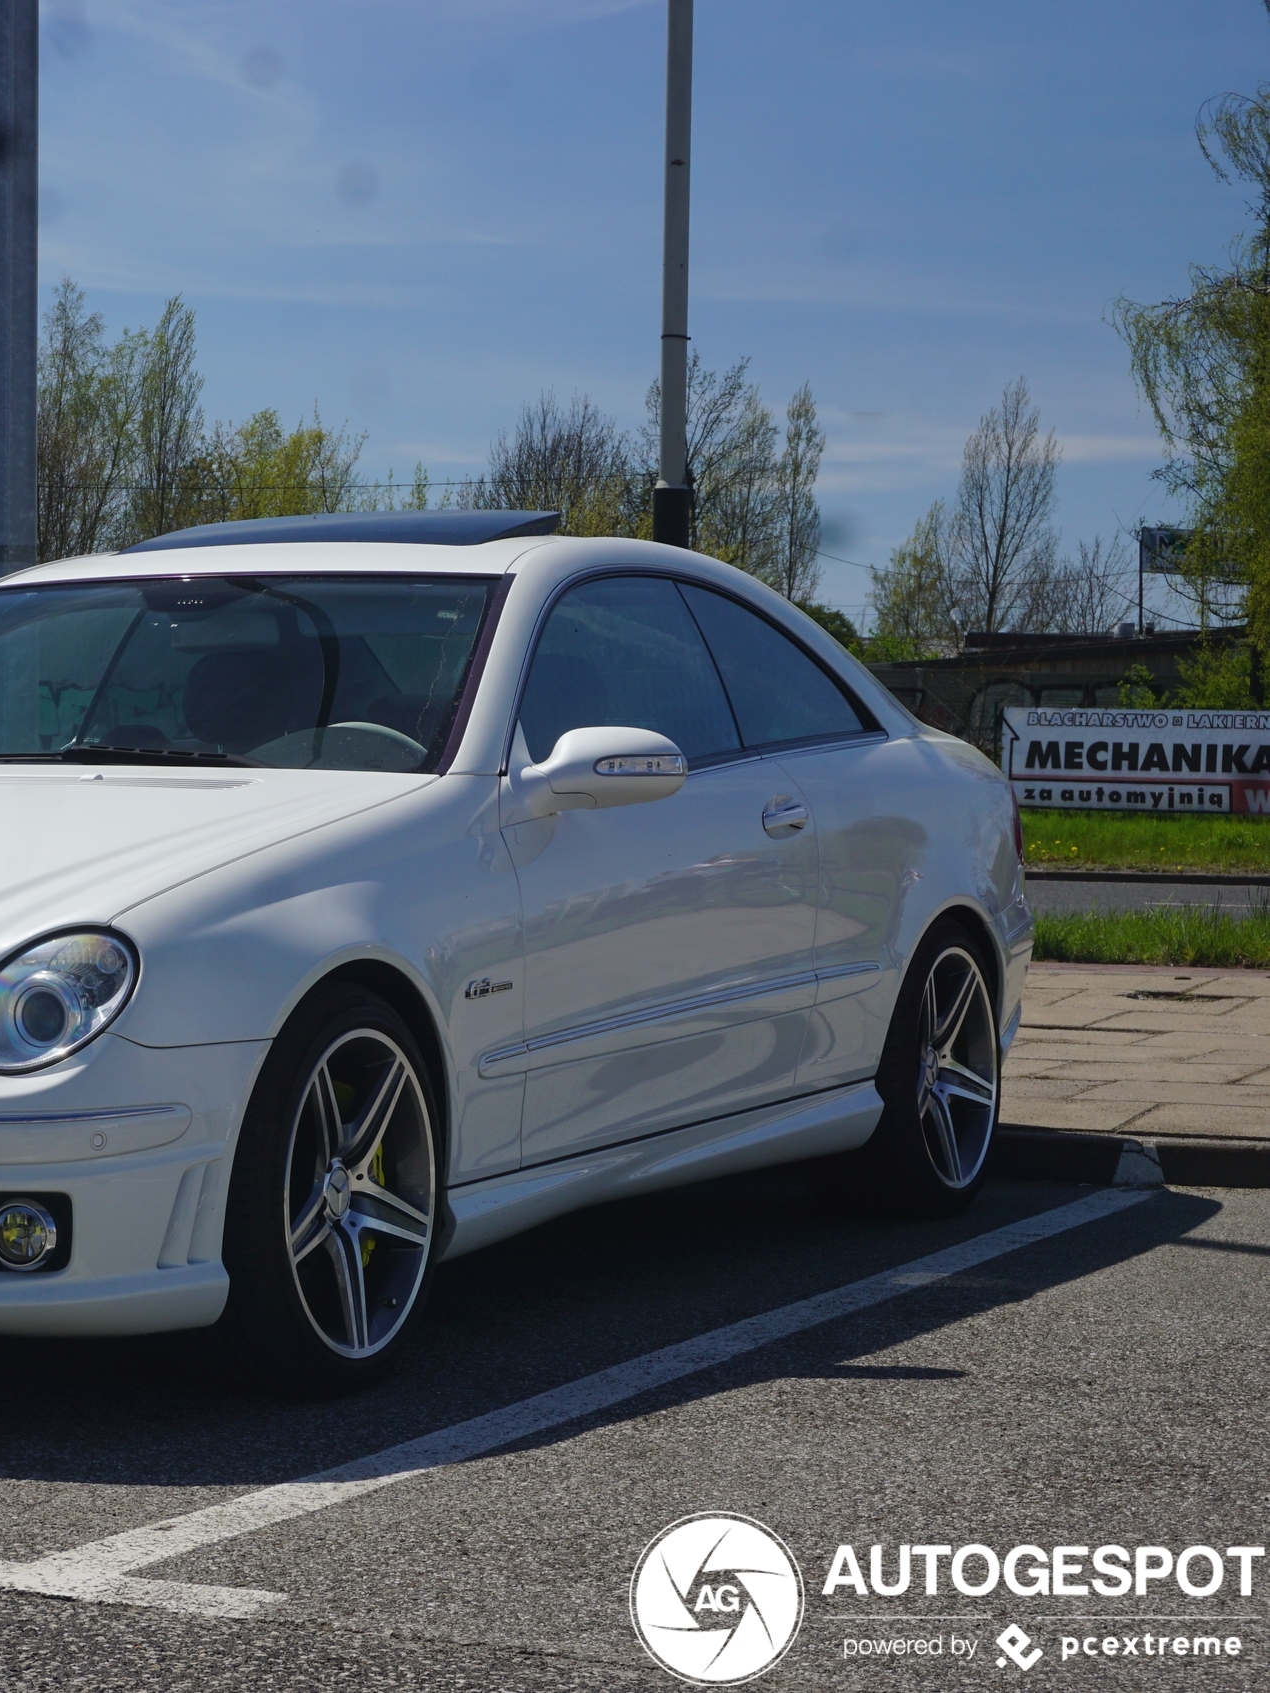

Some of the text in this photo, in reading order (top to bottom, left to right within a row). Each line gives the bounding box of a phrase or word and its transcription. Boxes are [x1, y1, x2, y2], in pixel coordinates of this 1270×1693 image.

[1027, 712, 1169, 728] BLACHARSTWO
[1024, 740, 1270, 774] MECHANIKA
[1024, 786, 1224, 809] za automyjnią
